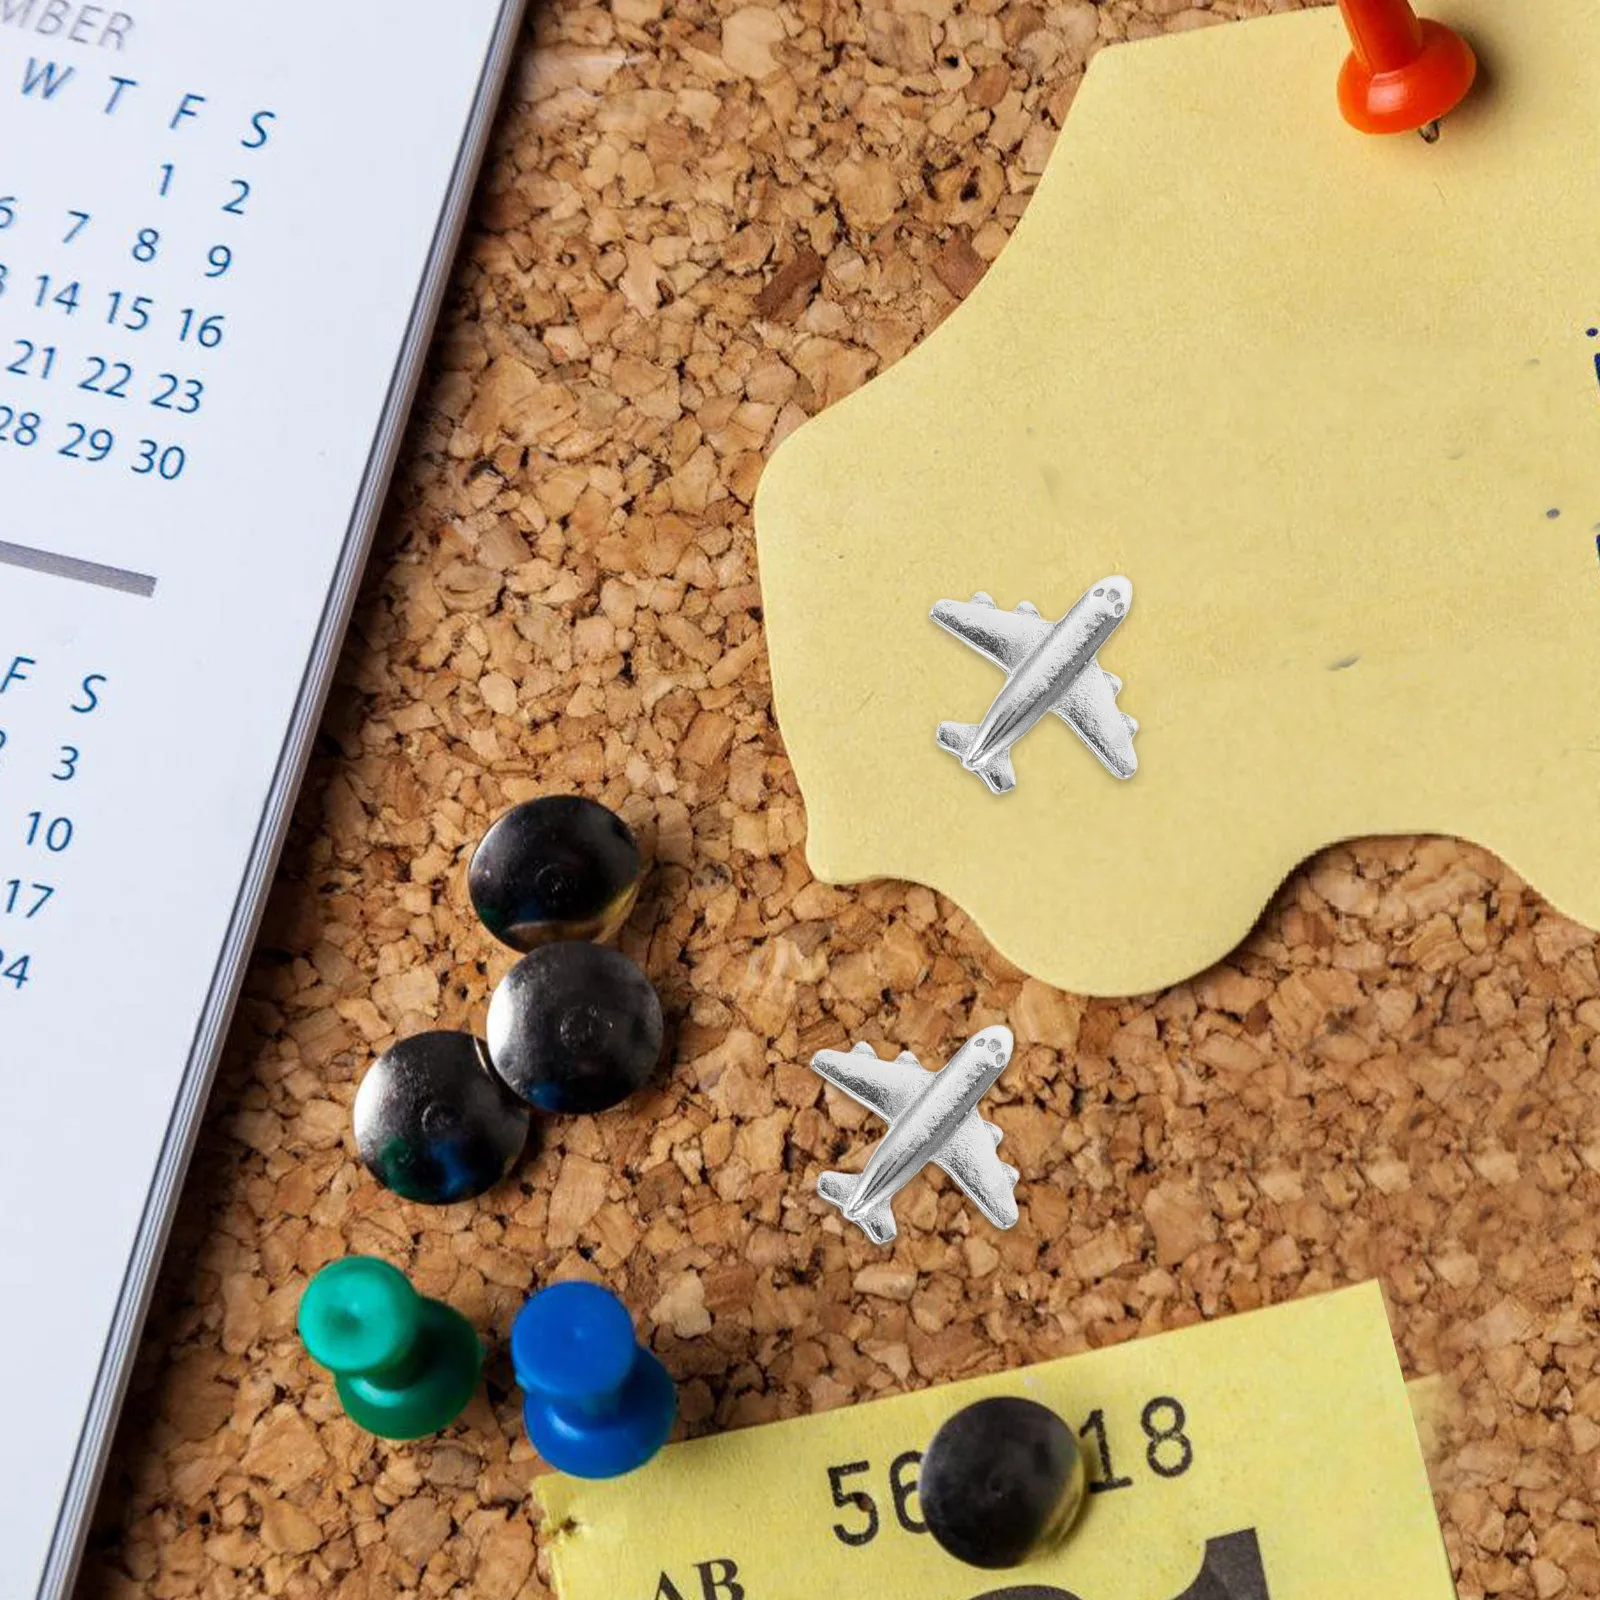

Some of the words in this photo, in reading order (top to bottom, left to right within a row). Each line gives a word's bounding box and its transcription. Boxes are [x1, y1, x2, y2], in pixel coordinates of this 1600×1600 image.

[21, 57, 75, 100] W
[104, 75, 139, 115] T
[169, 92, 207, 130] F
[240, 110, 277, 149] S
[159, 163, 175, 197] 1
[220, 178, 251, 216] 2
[62, 209, 91, 244] 7
[131, 227, 160, 263] 8
[203, 244, 233, 279] 9
[35, 274, 81, 316] 14
[107, 290, 154, 332] 15
[178, 307, 226, 349] 16
[5, 339, 57, 380] 21
[77, 355, 134, 399] 22
[149, 372, 205, 415] 23
[57, 421, 115, 463] 29
[130, 438, 187, 481] 30
[0, 655, 37, 695] F
[69, 673, 108, 714] S
[51, 745, 80, 782] 3
[26, 810, 74, 853] 10
[5, 878, 55, 919] 17
[0, 948, 31, 990] 4
[827, 1396, 1193, 1547] 5618
